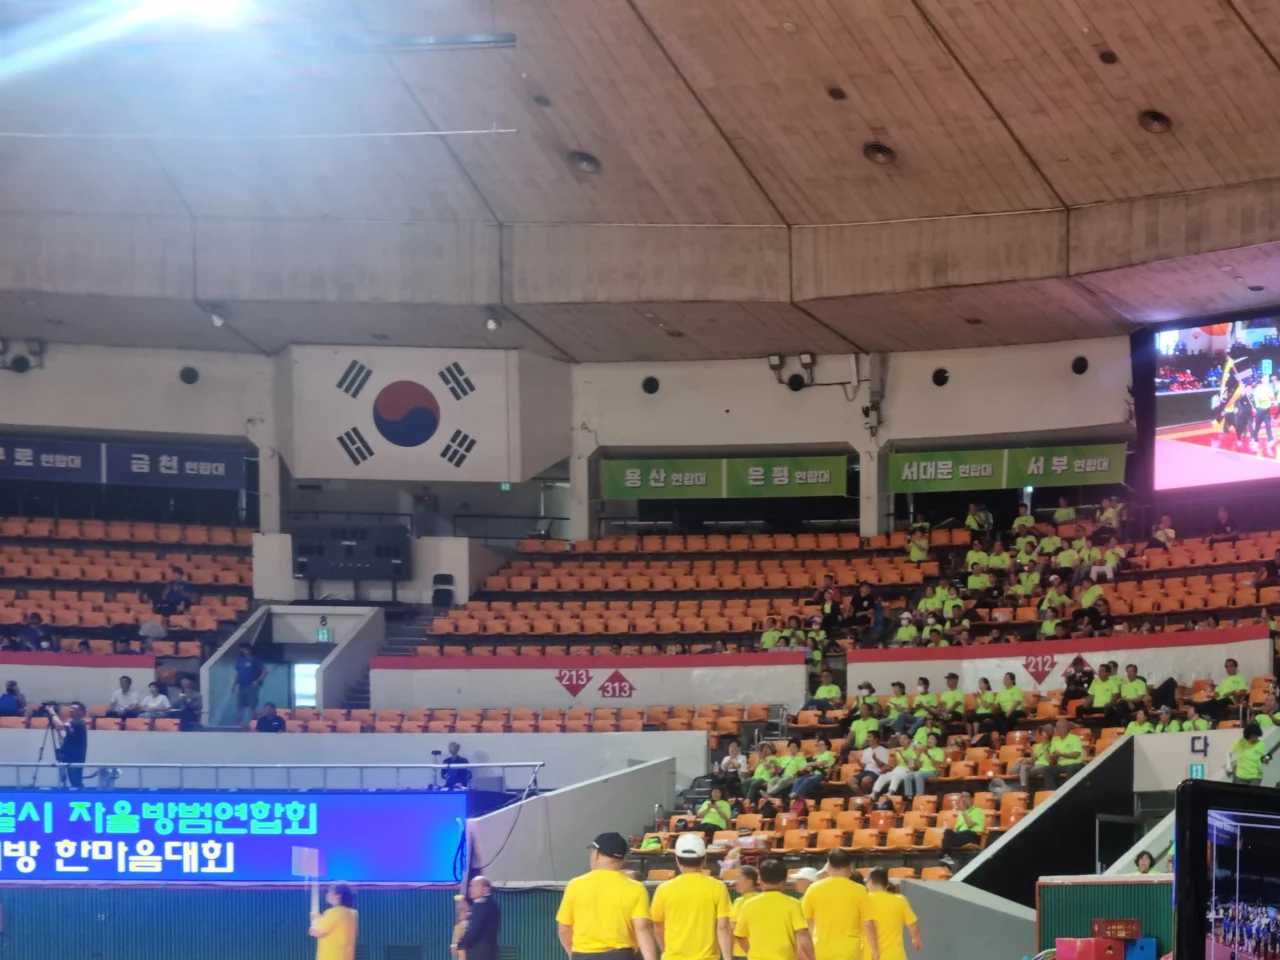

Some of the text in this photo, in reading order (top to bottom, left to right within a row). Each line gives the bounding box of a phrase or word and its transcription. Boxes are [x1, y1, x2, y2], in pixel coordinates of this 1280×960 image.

[40, 453, 82, 468] 연합대
[185, 461, 225, 476] 연합대
[1027, 456, 1109, 475] 서부 연합대
[625, 468, 706, 487] 용산 연합대
[748, 467, 830, 485] 은평 연합대
[902, 460, 993, 480] 서대문 연합대
[320, 616, 327, 626] 8
[1028, 655, 1052, 672] 212
[561, 670, 587, 684] 213
[604, 682, 630, 697] 313
[1191, 735, 1209, 757] 다
[69, 801, 317, 835] 자율방범연합회
[0, 839, 234, 873] 방 한마음대회
